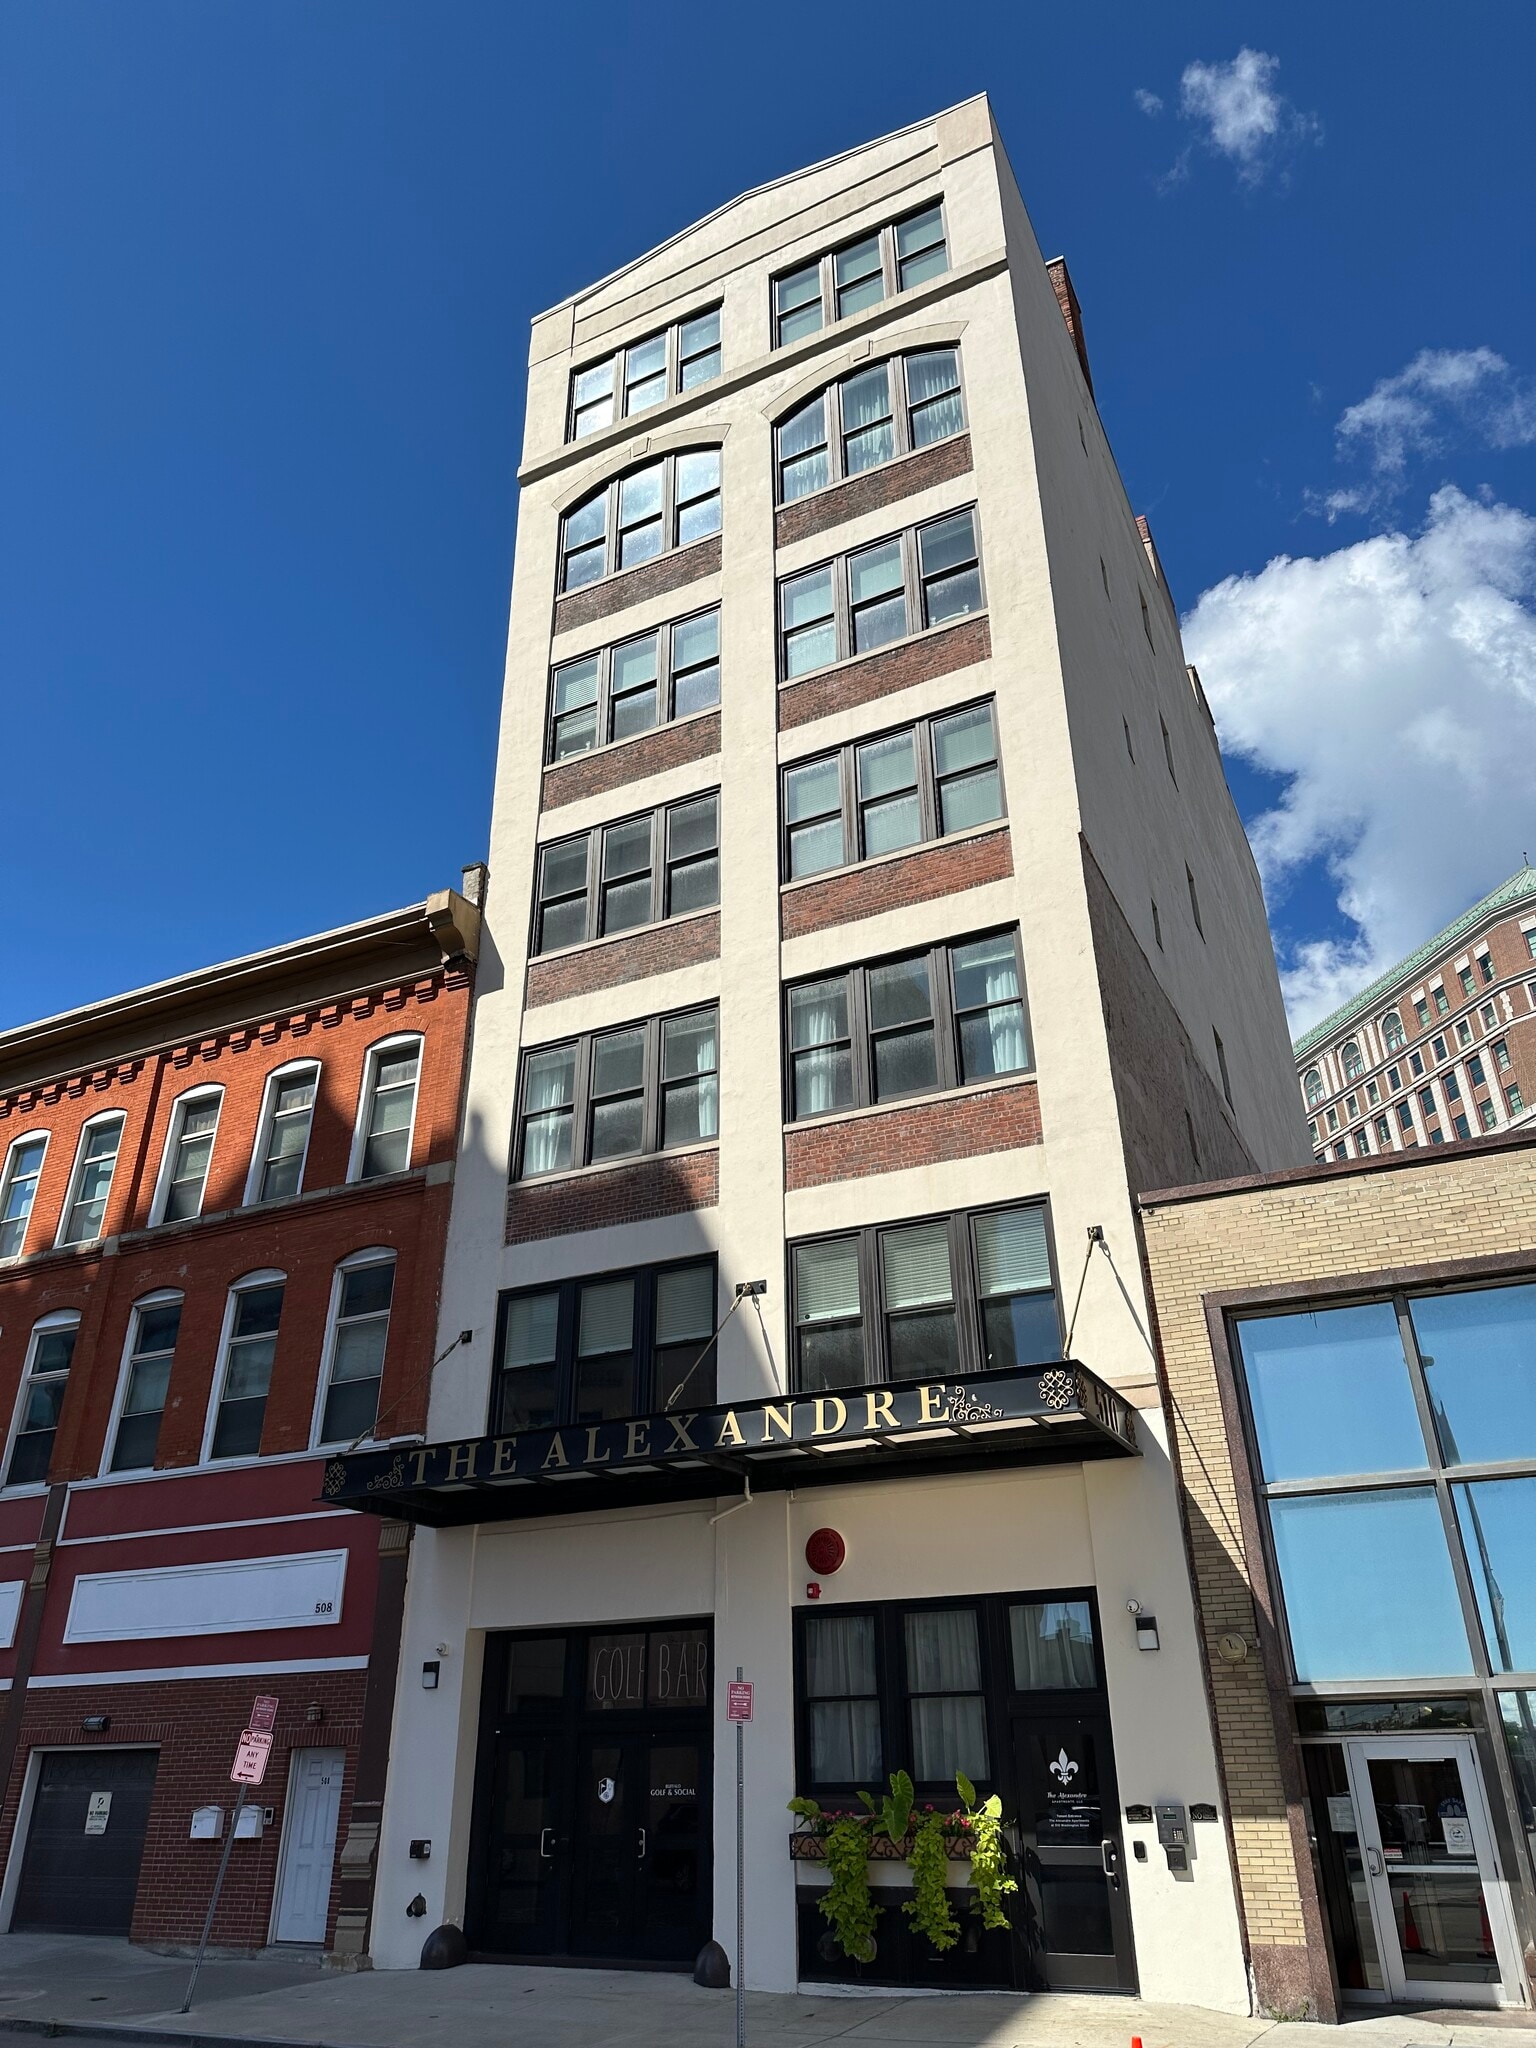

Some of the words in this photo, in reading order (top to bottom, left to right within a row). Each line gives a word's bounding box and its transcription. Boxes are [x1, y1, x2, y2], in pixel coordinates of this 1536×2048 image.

[1094, 1385, 1119, 1435] 510
[408, 1437, 518, 1486] THE
[541, 1383, 951, 1468] ALEXANDRE
[315, 1602, 333, 1613] 508
[658, 1642, 708, 1699] BAR
[241, 1733, 251, 1744] NO
[251, 1735, 271, 1745] PARKING
[243, 1761, 257, 1769] TIME
